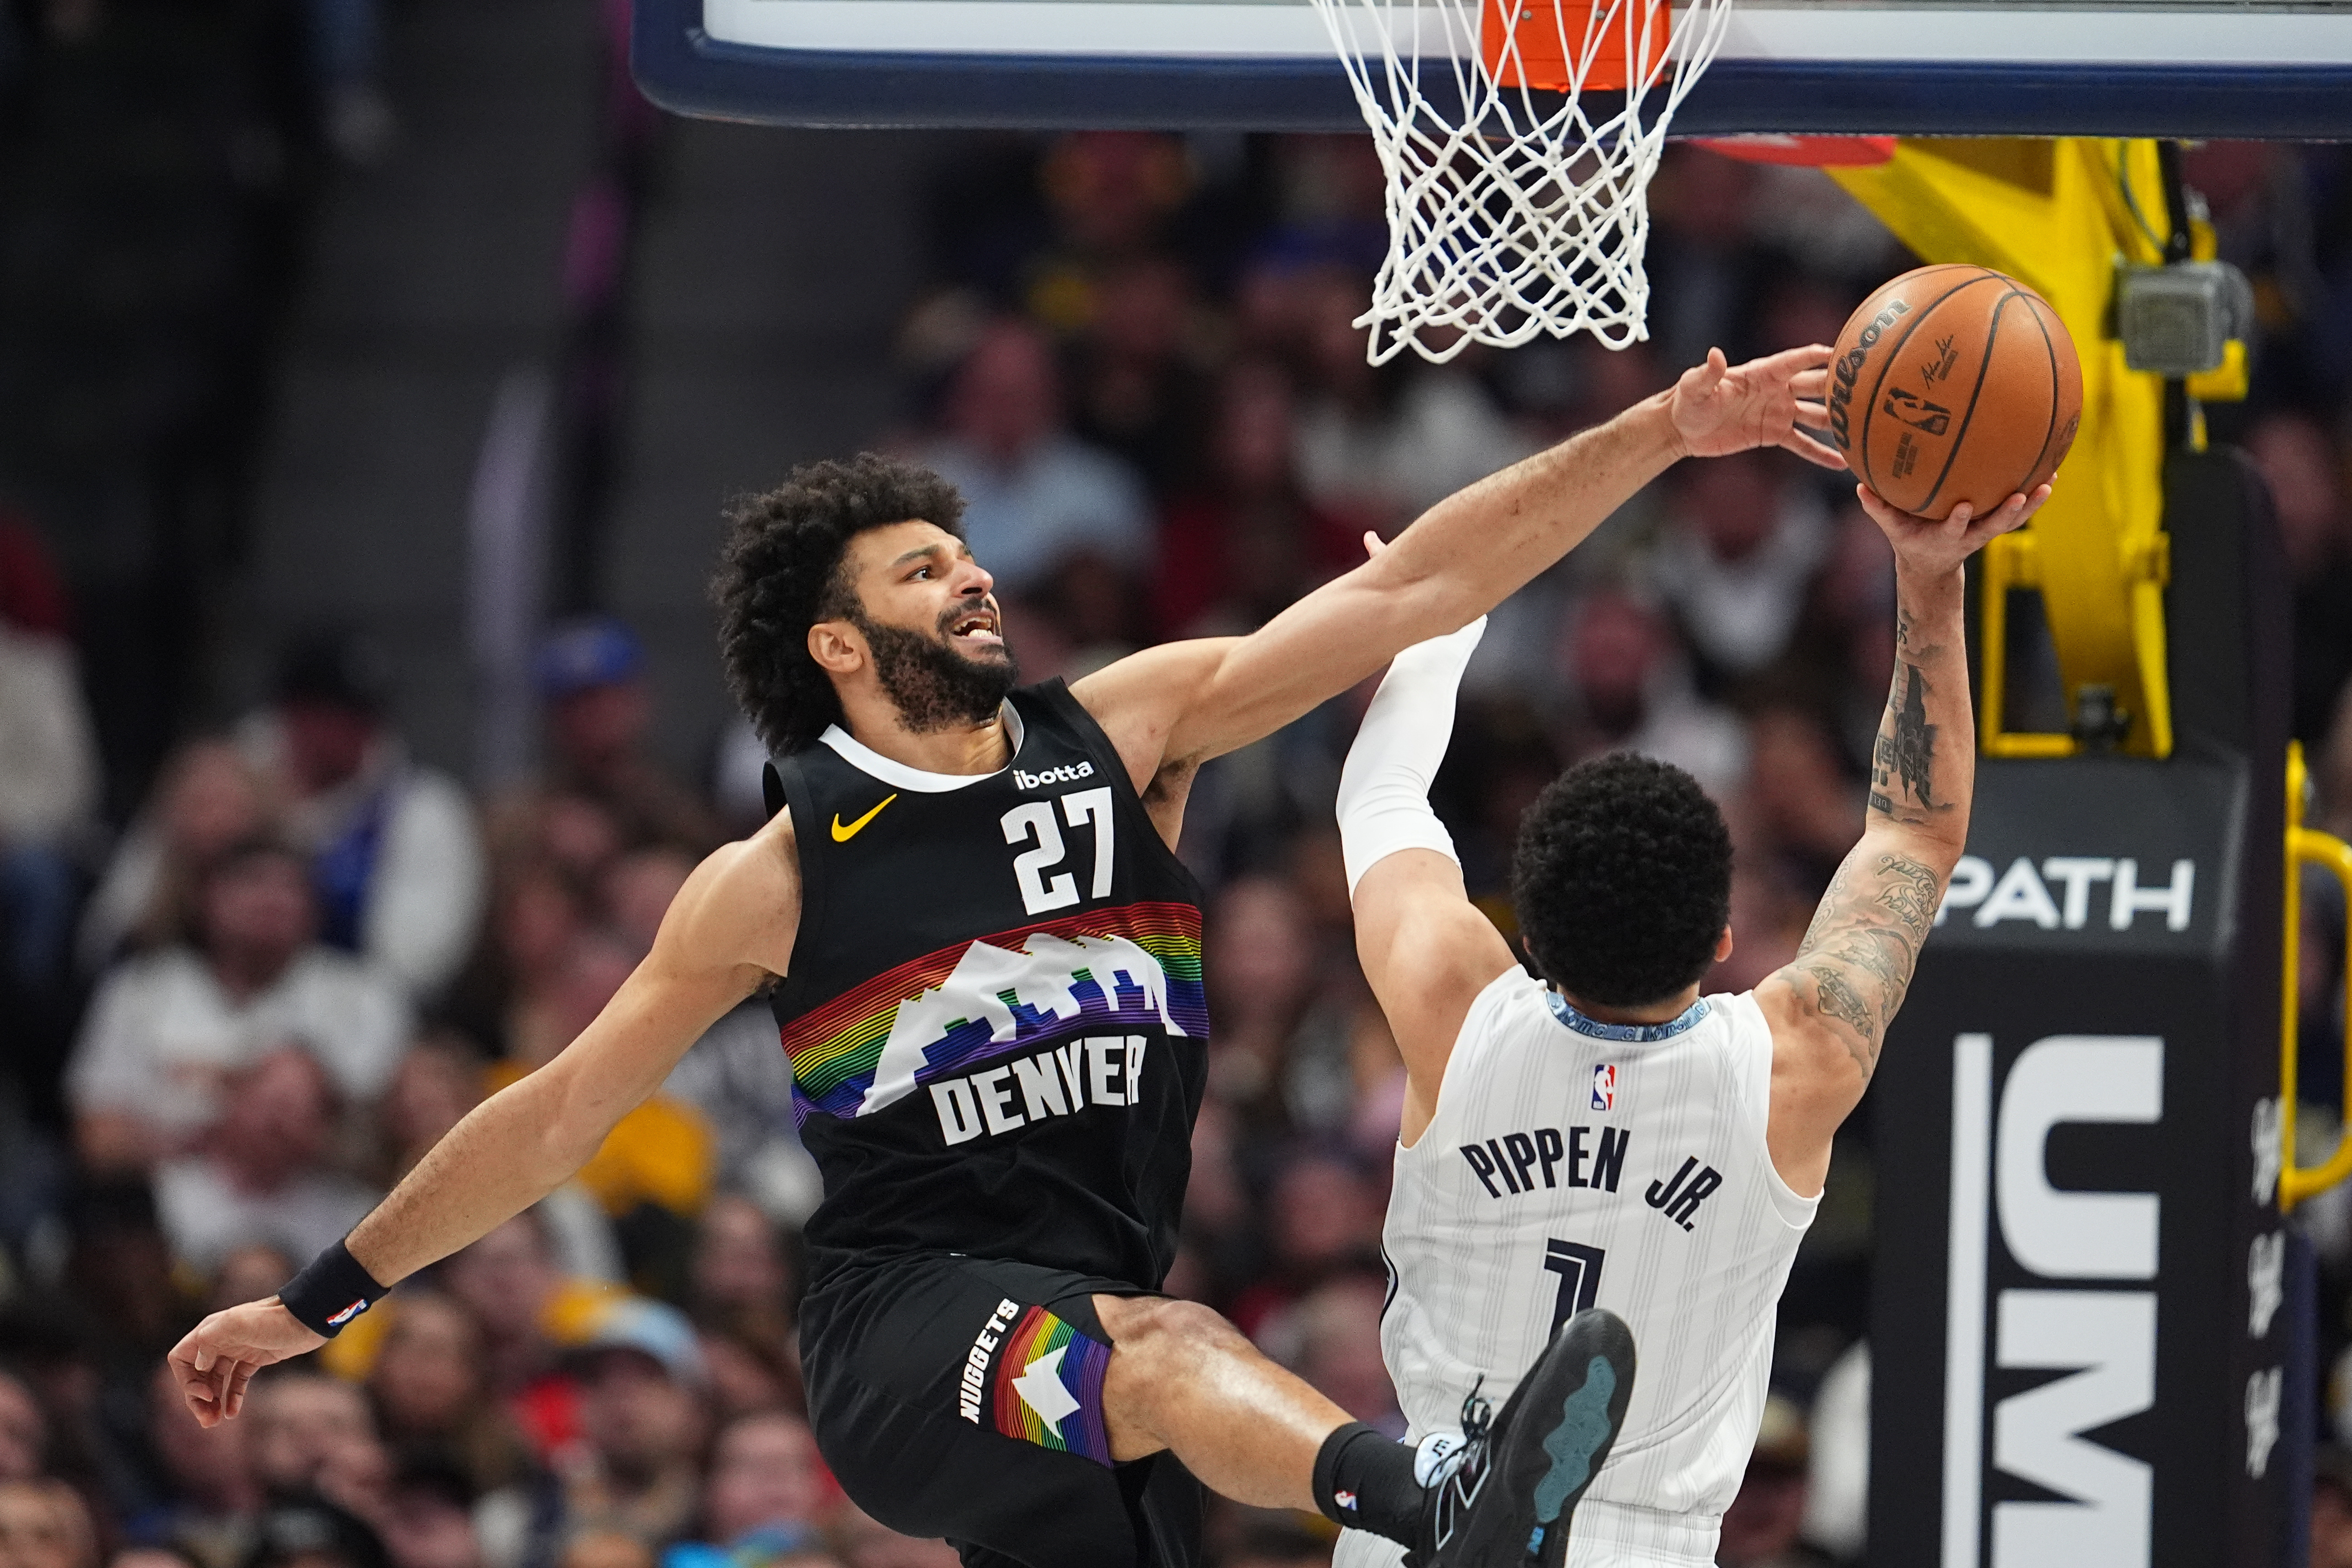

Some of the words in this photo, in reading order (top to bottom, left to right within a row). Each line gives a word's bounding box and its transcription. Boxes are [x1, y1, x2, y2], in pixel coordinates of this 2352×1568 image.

[1830, 298, 1912, 450] Wilson
[1013, 761, 1094, 790] ibotta
[1000, 786, 1114, 915] 27
[1932, 854, 2195, 932] PATH
[929, 1035, 1147, 1146] DENVER
[1460, 1126, 1630, 1199] PIPPEN
[1645, 1156, 1723, 1232] JR.
[960, 1298, 1019, 1425] NUGGETS
